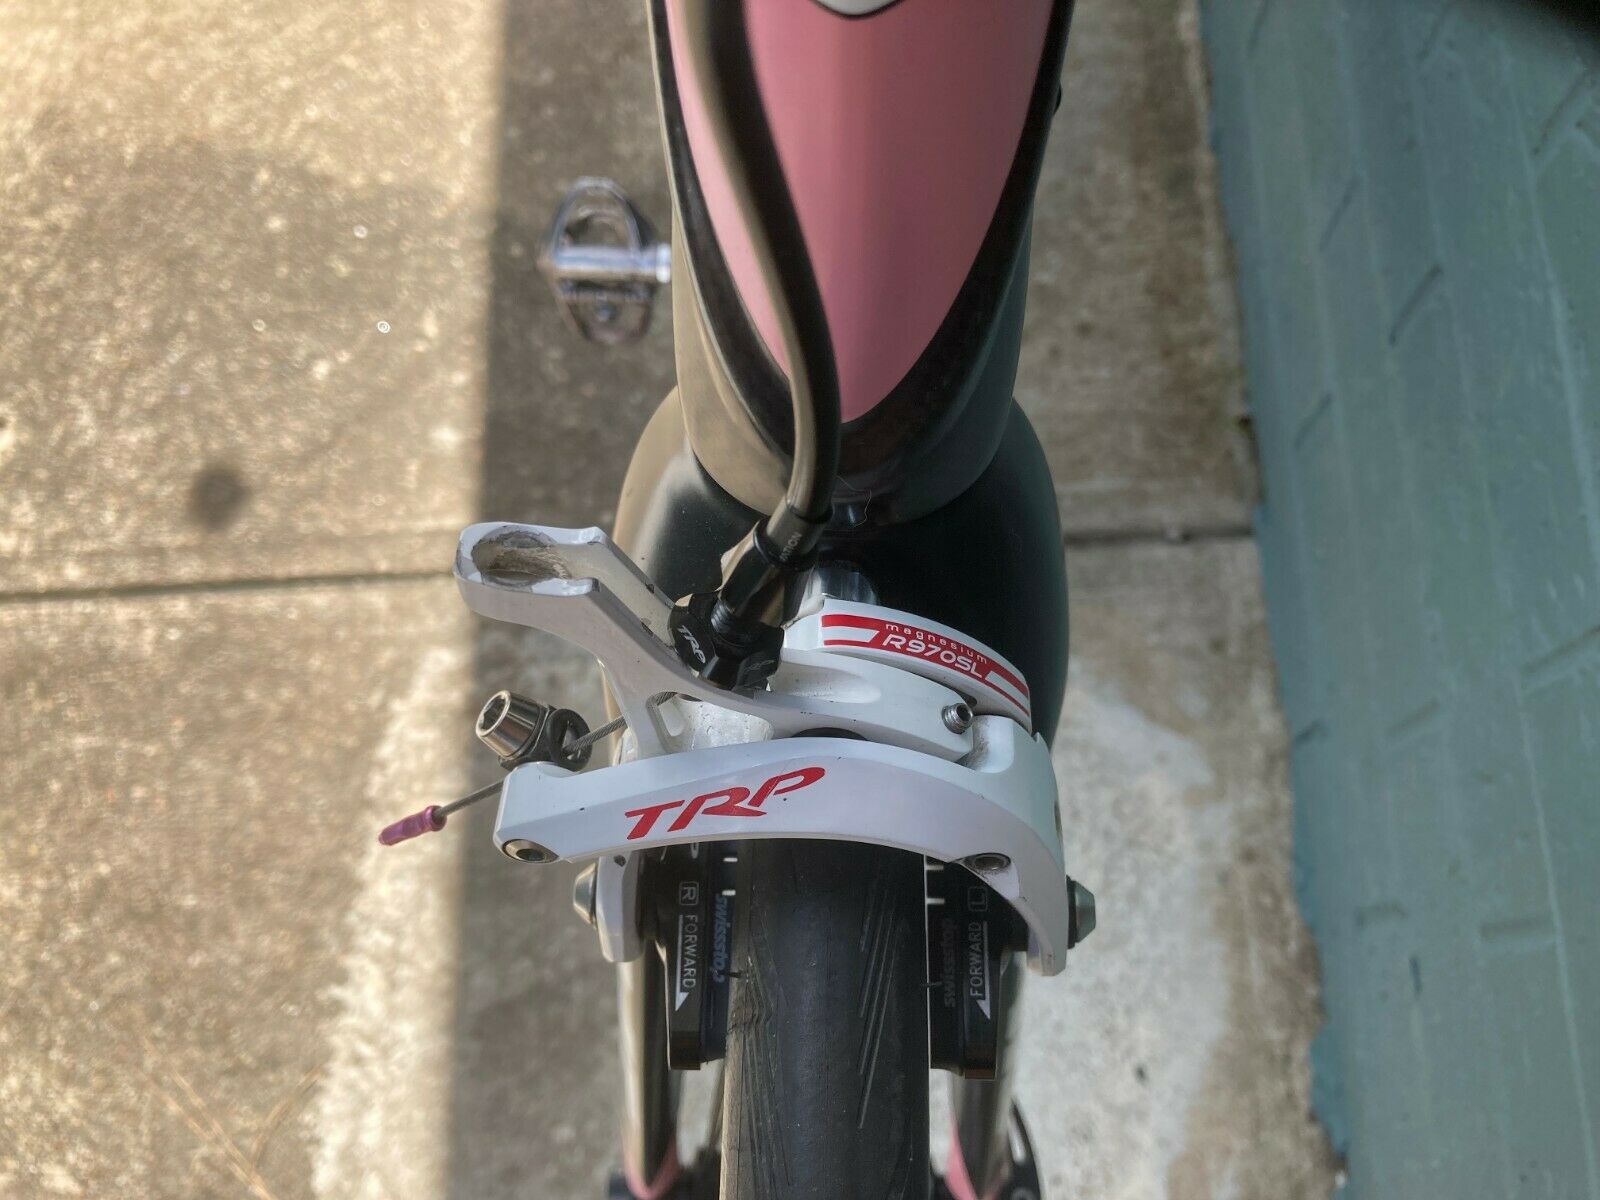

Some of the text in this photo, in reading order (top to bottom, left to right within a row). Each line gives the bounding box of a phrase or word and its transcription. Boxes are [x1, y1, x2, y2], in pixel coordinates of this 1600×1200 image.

[677, 624, 706, 664] TRP
[882, 633, 982, 678] R970SL
[885, 623, 987, 665] magnesium
[624, 766, 826, 840] TRP
[682, 914, 698, 989] FORWARD
[968, 921, 983, 997] FORWARD
